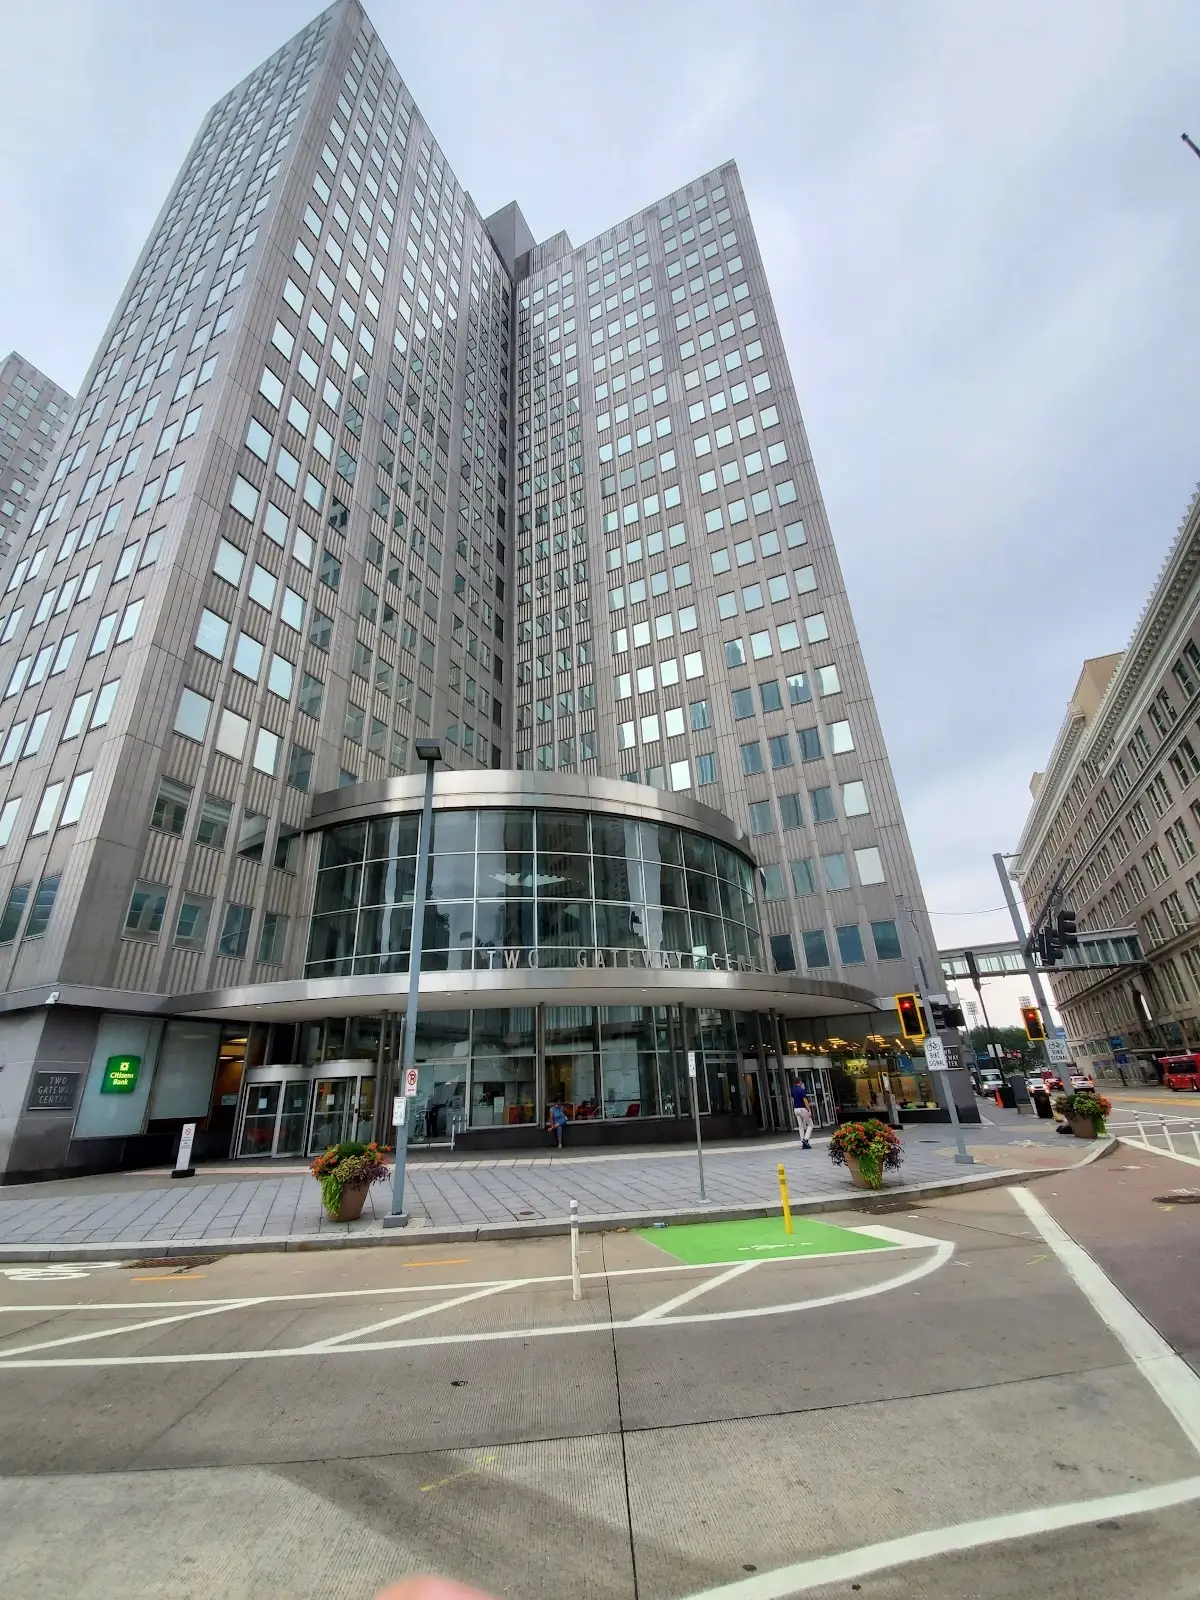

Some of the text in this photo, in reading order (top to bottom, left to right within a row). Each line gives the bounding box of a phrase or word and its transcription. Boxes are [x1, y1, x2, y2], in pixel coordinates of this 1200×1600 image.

[487, 950, 539, 969] TWO
[577, 949, 683, 968] GATEWAY
[50, 1076, 67, 1085] TWO
[38, 1085, 73, 1094] GATEWA
